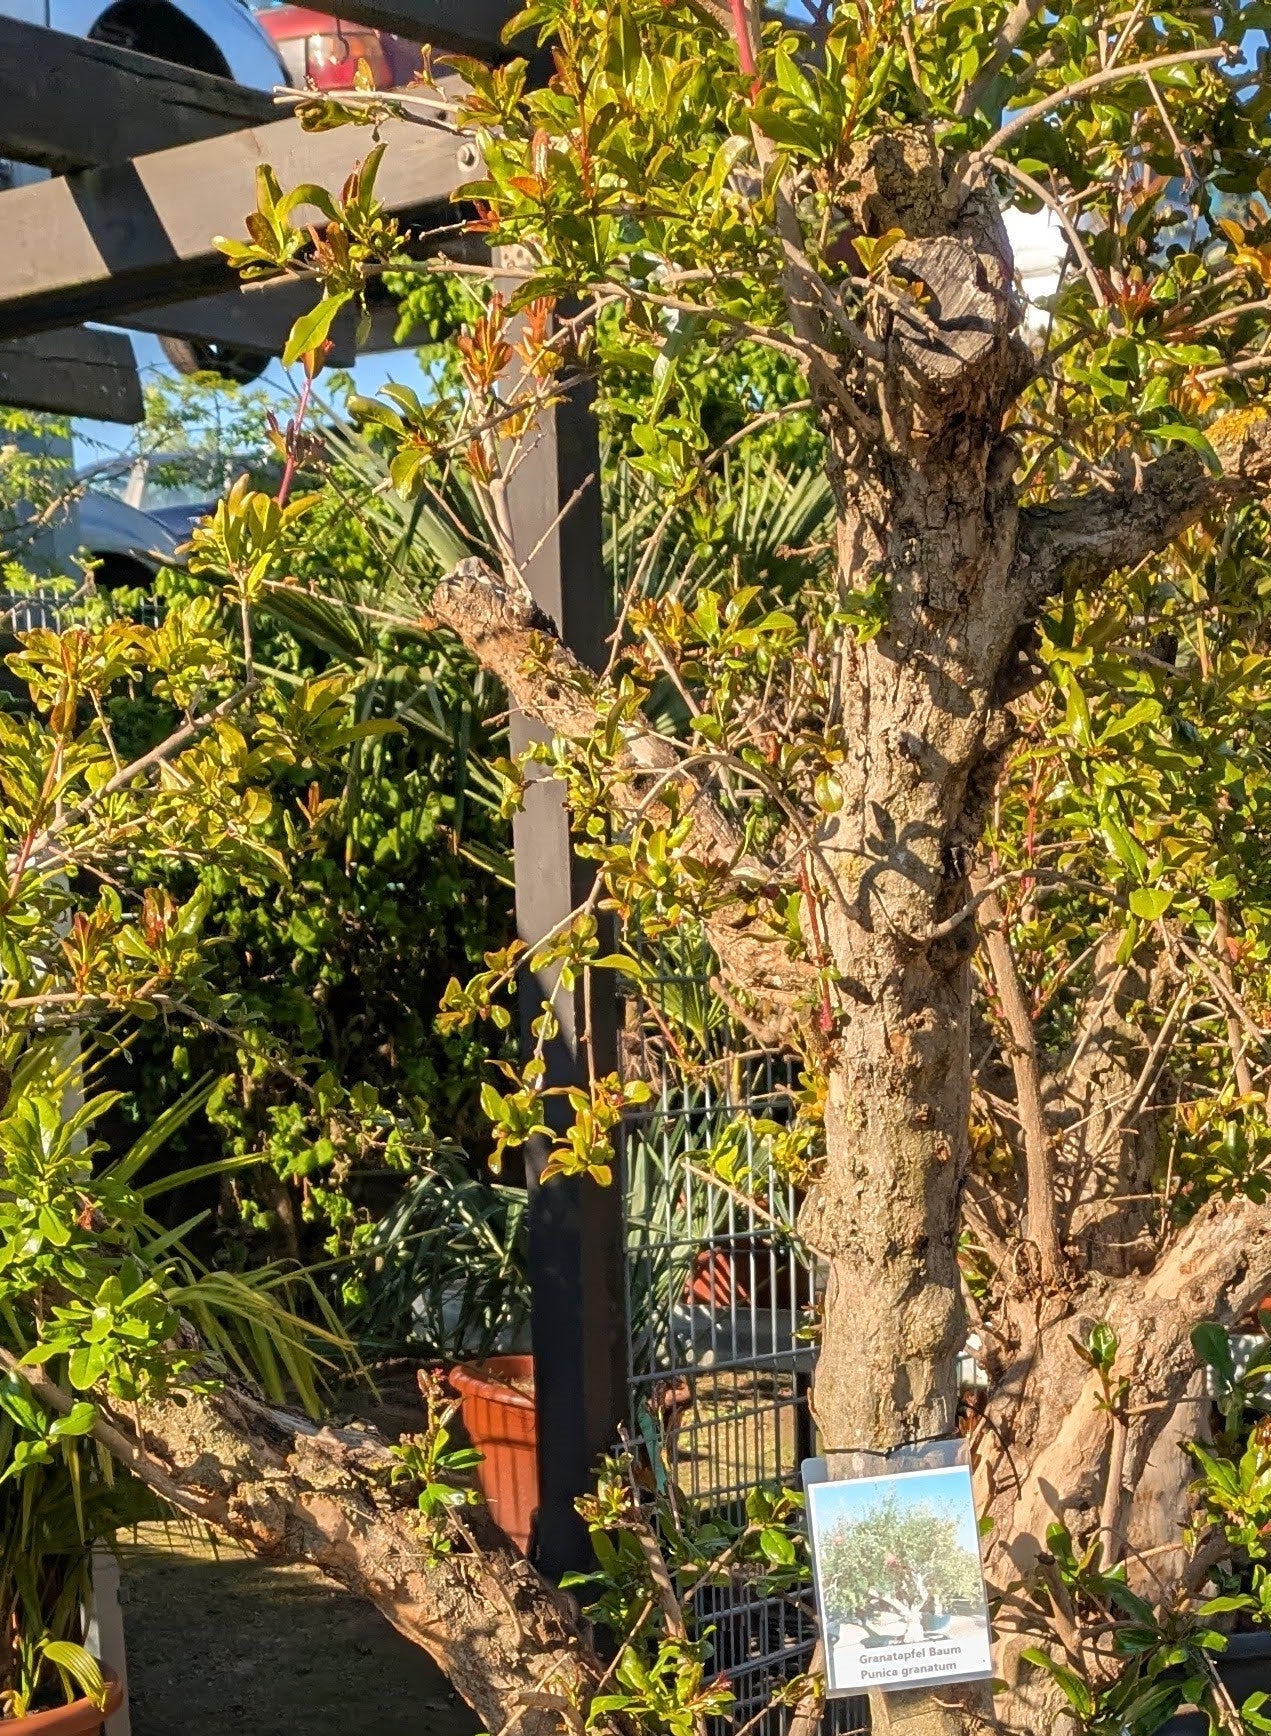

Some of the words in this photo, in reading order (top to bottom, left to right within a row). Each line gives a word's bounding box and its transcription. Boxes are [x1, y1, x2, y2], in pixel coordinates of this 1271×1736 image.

[859, 1648, 926, 1664] Granatapfel
[929, 1645, 962, 1657] Baum
[860, 1668, 898, 1680] Punica
[901, 1661, 957, 1677] granatum
